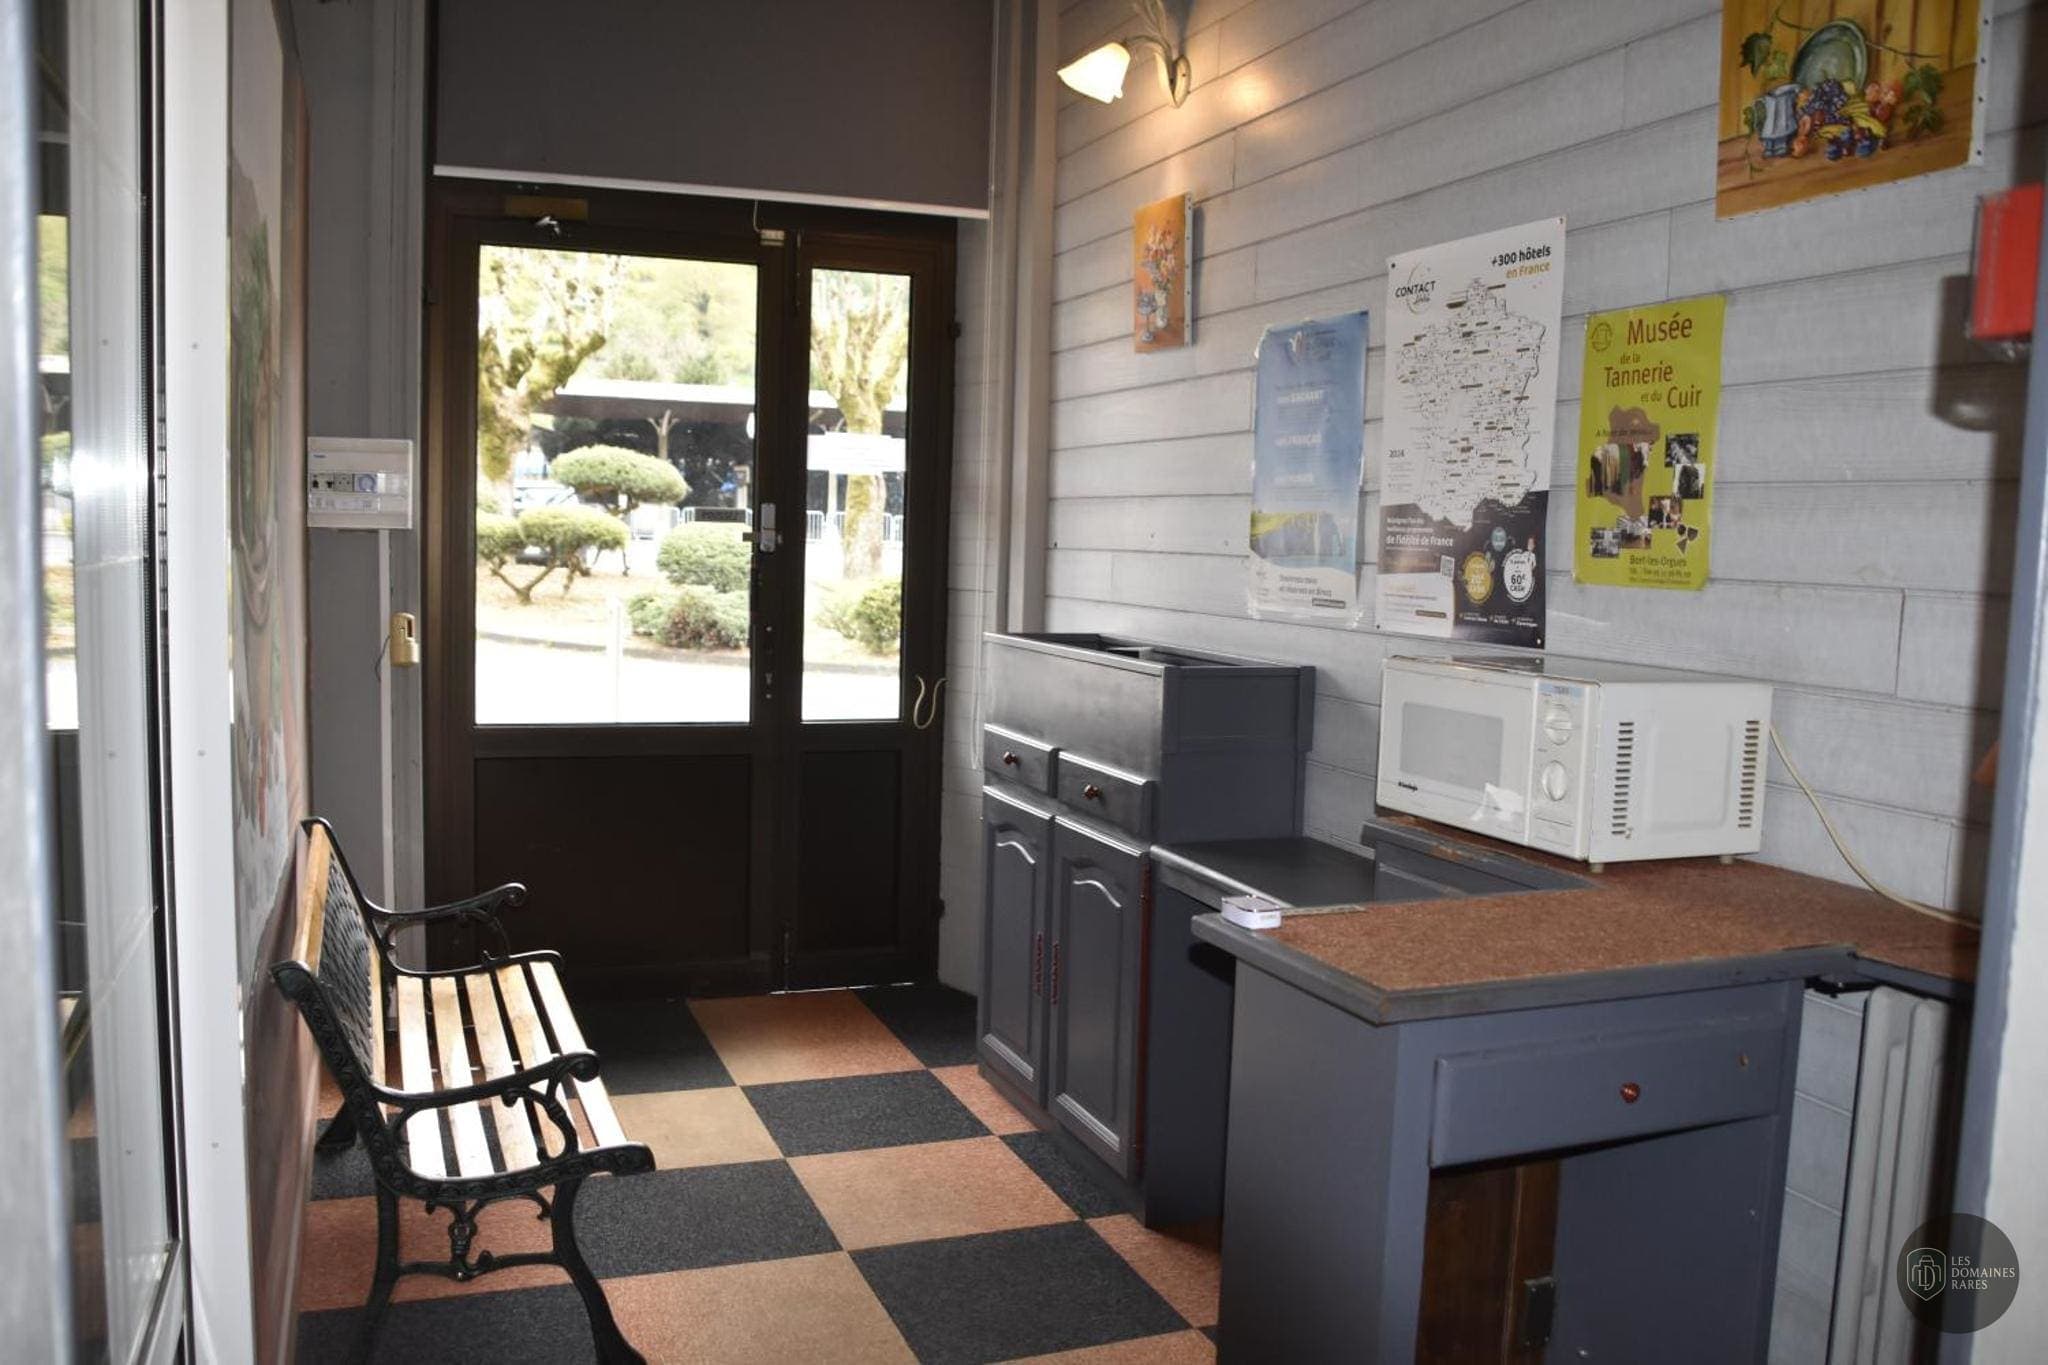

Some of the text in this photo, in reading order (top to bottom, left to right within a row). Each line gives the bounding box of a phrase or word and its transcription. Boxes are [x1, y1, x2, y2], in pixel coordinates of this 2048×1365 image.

[1492, 245, 1551, 267] +300 hôtels
[1505, 262, 1551, 279] en France
[1395, 280, 1436, 298] CONTACT
[1627, 312, 1693, 346] Musée
[1620, 352, 1641, 364] de la
[1604, 361, 1674, 387] Tannerie
[1650, 390, 1662, 402] du
[1667, 384, 1702, 409] Cuir
